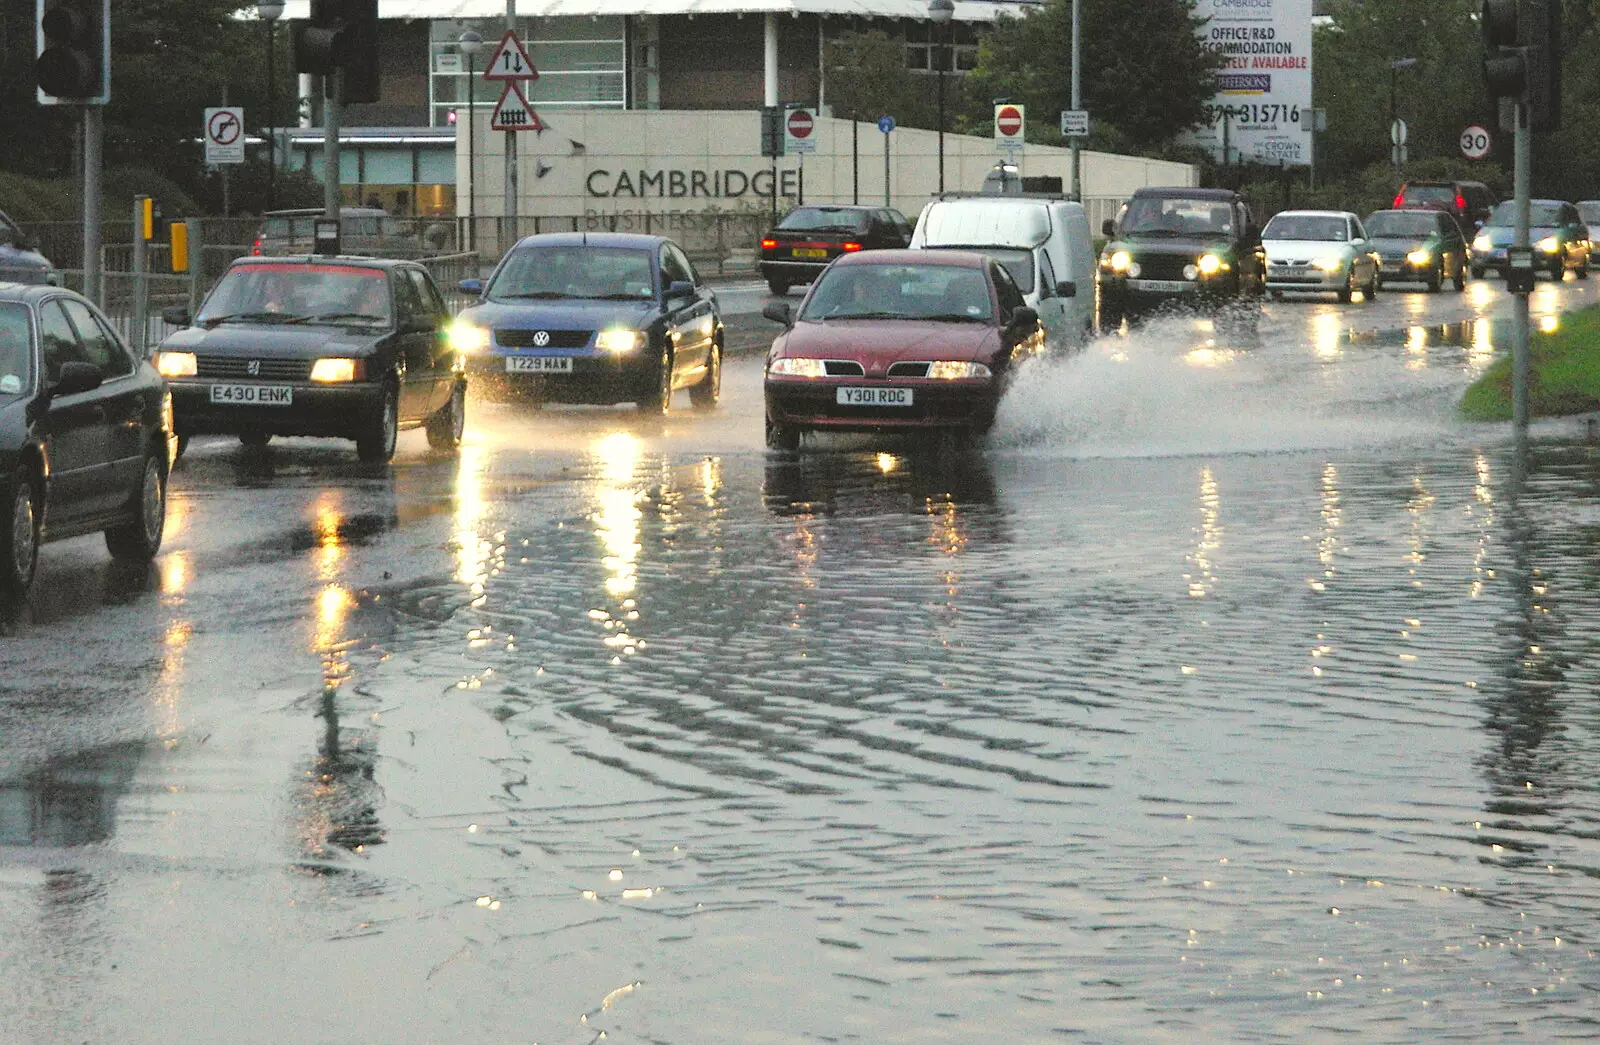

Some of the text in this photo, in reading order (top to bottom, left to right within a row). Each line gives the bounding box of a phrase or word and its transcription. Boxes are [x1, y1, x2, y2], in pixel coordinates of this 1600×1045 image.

[1211, 27, 1275, 40] OFFICE/R&D
[1252, 56, 1307, 69] AVAILABLE
[1240, 104, 1300, 122] 315716
[1265, 141, 1301, 150] CROWN
[1462, 134, 1487, 150] 30
[1265, 150, 1301, 159] ESTATE
[587, 169, 798, 197] CAMBRIDGE
[511, 356, 541, 369] T229
[213, 386, 290, 402] E430 ENK
